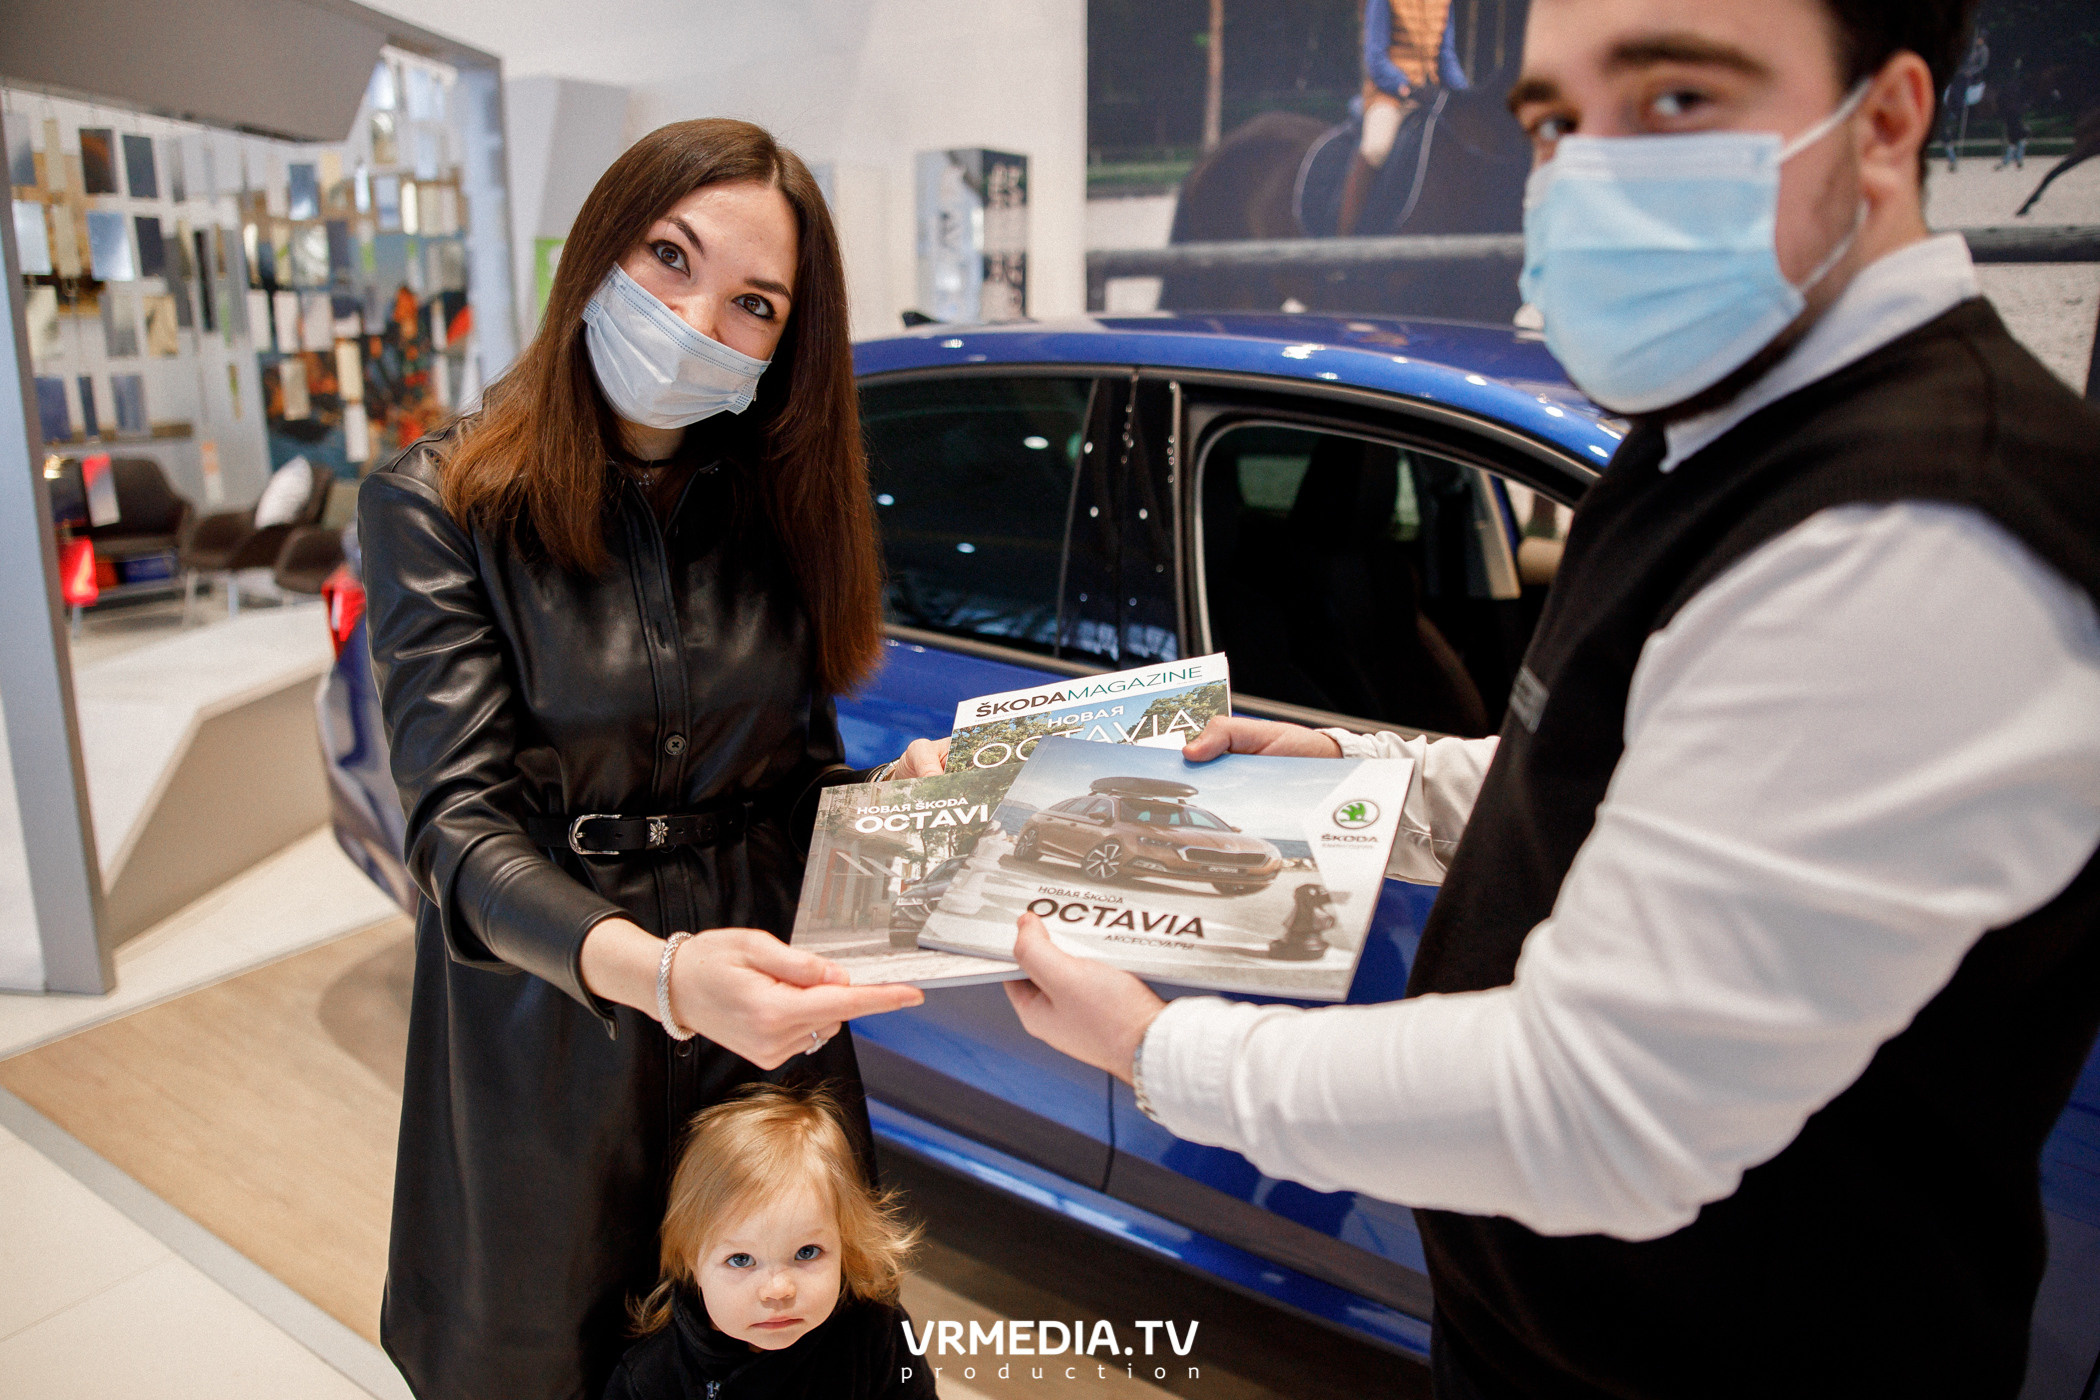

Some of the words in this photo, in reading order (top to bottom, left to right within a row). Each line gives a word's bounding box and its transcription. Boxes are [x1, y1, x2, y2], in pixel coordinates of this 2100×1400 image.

[1047, 705, 1124, 728] НОВАЯ
[856, 803, 911, 815] НОВАЯ
[914, 797, 968, 810] ŠKODA
[854, 804, 989, 833] OCTAVI
[1037, 886, 1080, 898] НОВАЯ
[1083, 891, 1124, 904] ŠKODA
[1027, 898, 1204, 938] OCTAVIA
